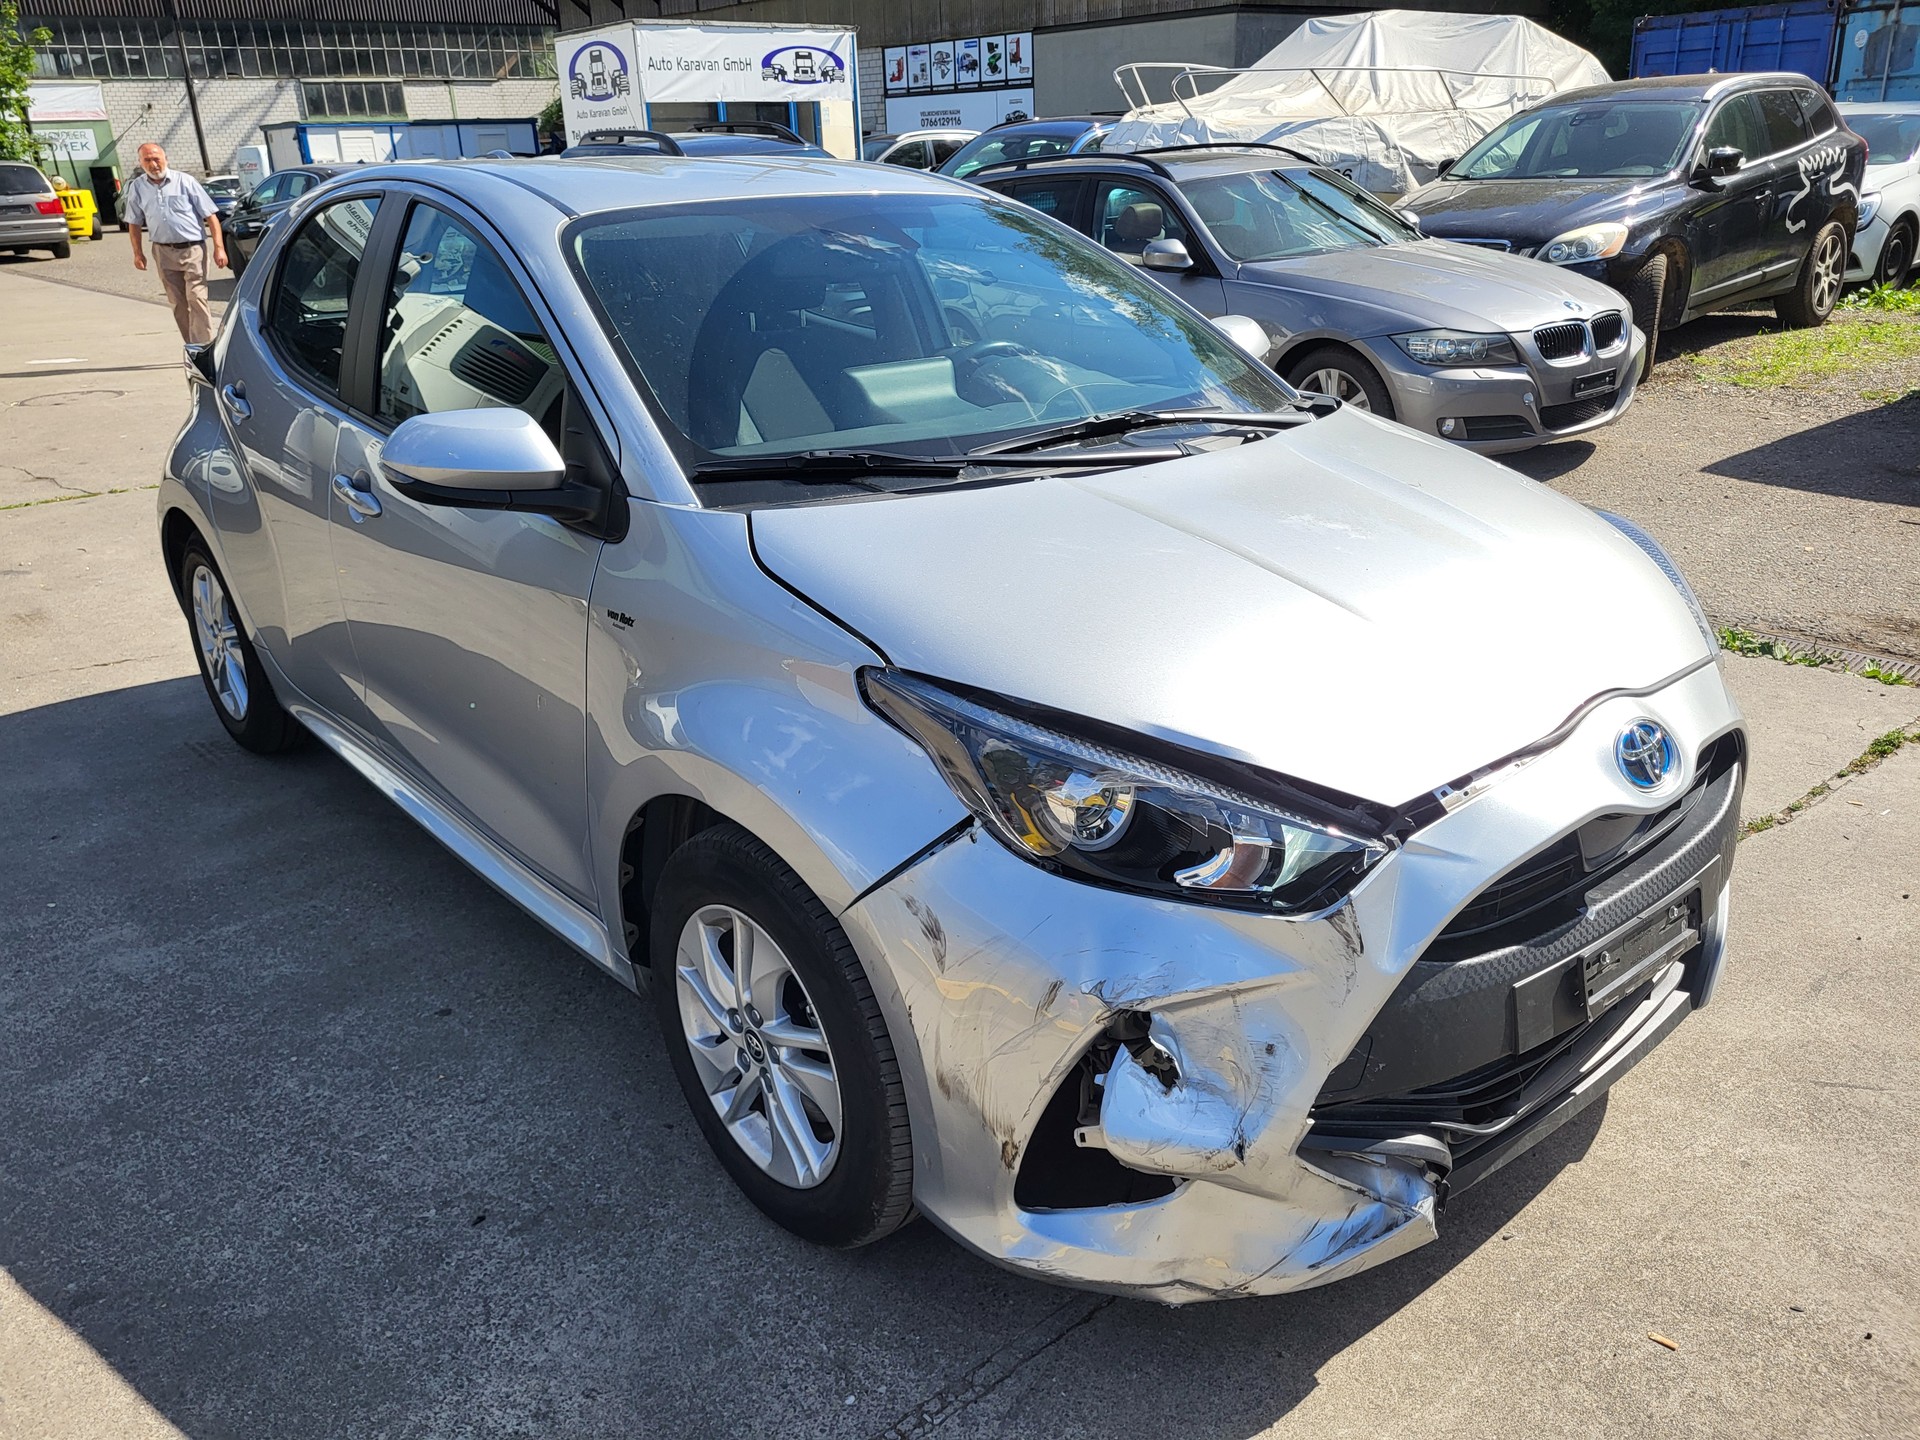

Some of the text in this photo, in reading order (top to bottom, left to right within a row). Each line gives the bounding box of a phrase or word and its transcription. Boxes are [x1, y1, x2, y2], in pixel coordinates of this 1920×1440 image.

[648, 56, 753, 72] Auto Karavan GmbH
[577, 106, 627, 119] Auto Karavan GmbH
[920, 116, 962, 128] 0766129116
